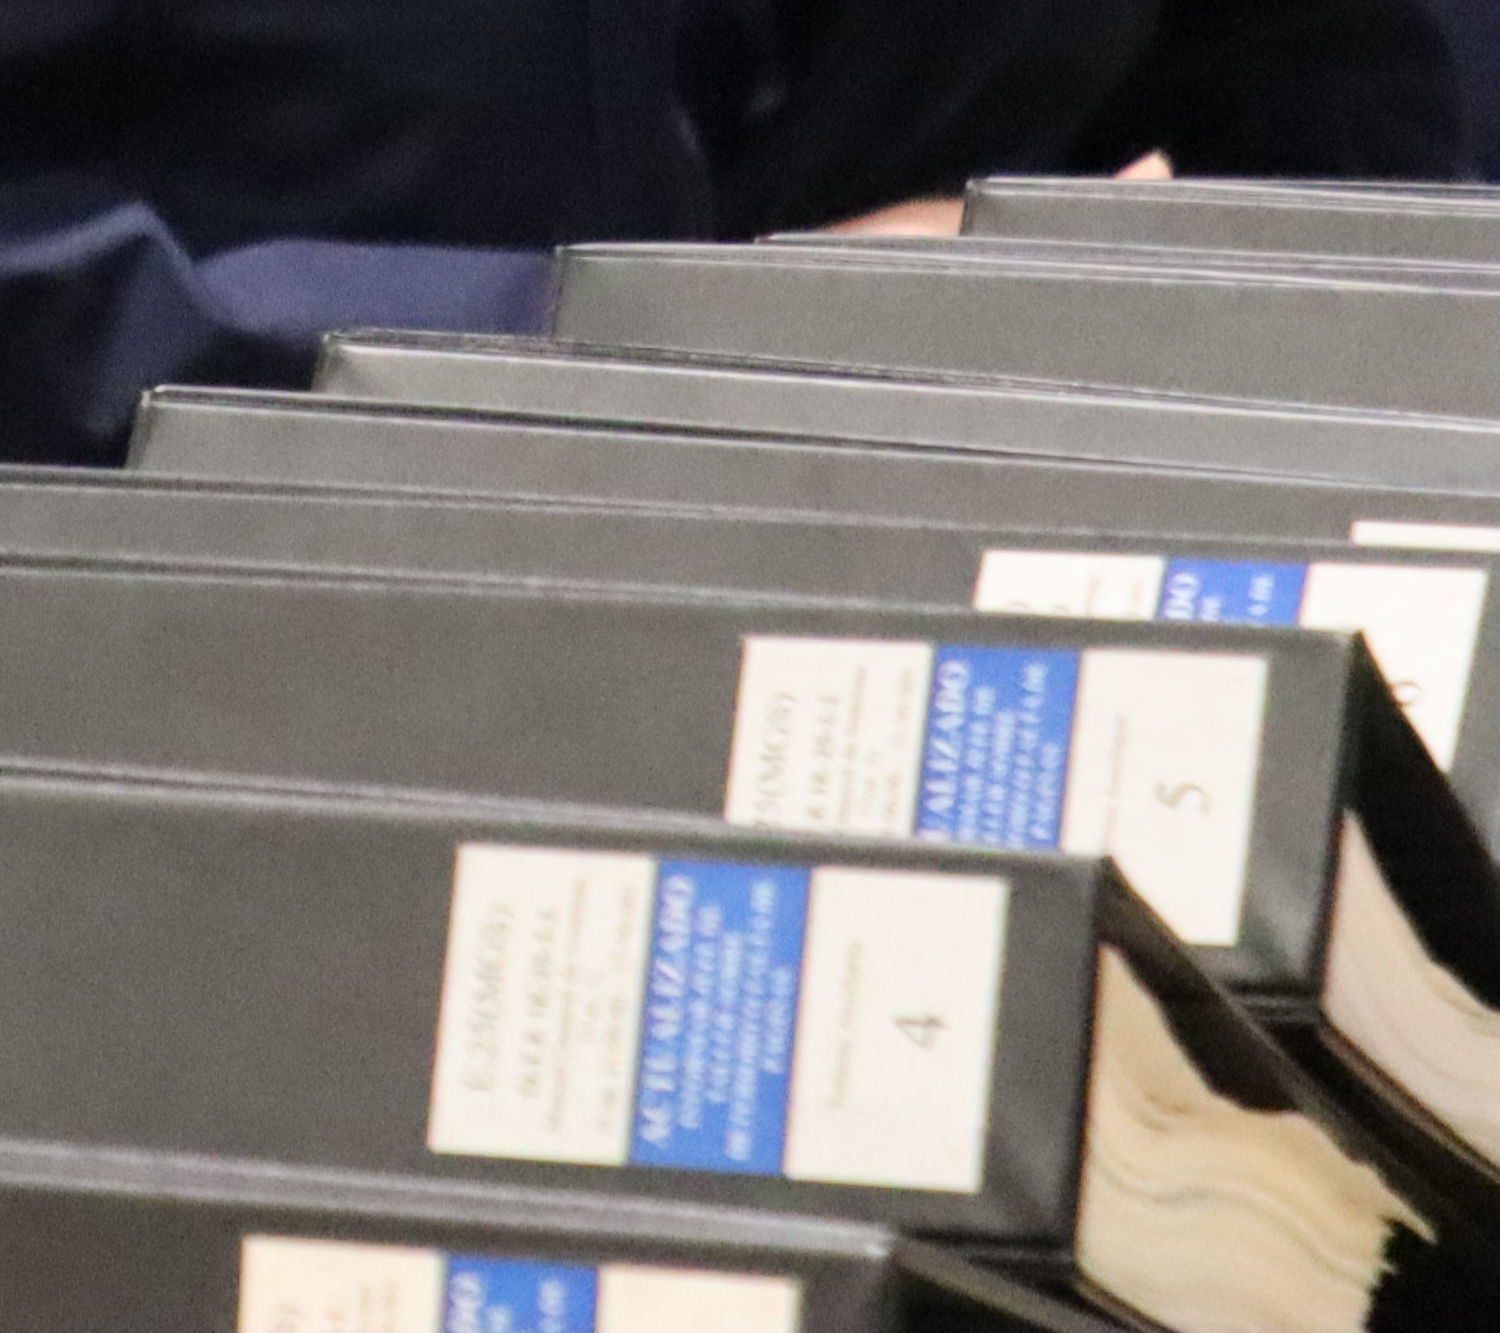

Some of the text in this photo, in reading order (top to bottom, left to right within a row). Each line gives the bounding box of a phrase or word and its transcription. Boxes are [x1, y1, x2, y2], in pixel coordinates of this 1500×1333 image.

[1154, 781, 1212, 816] 5
[640, 875, 693, 1145] ACTUALIZADO
[891, 1014, 947, 1050] 4
